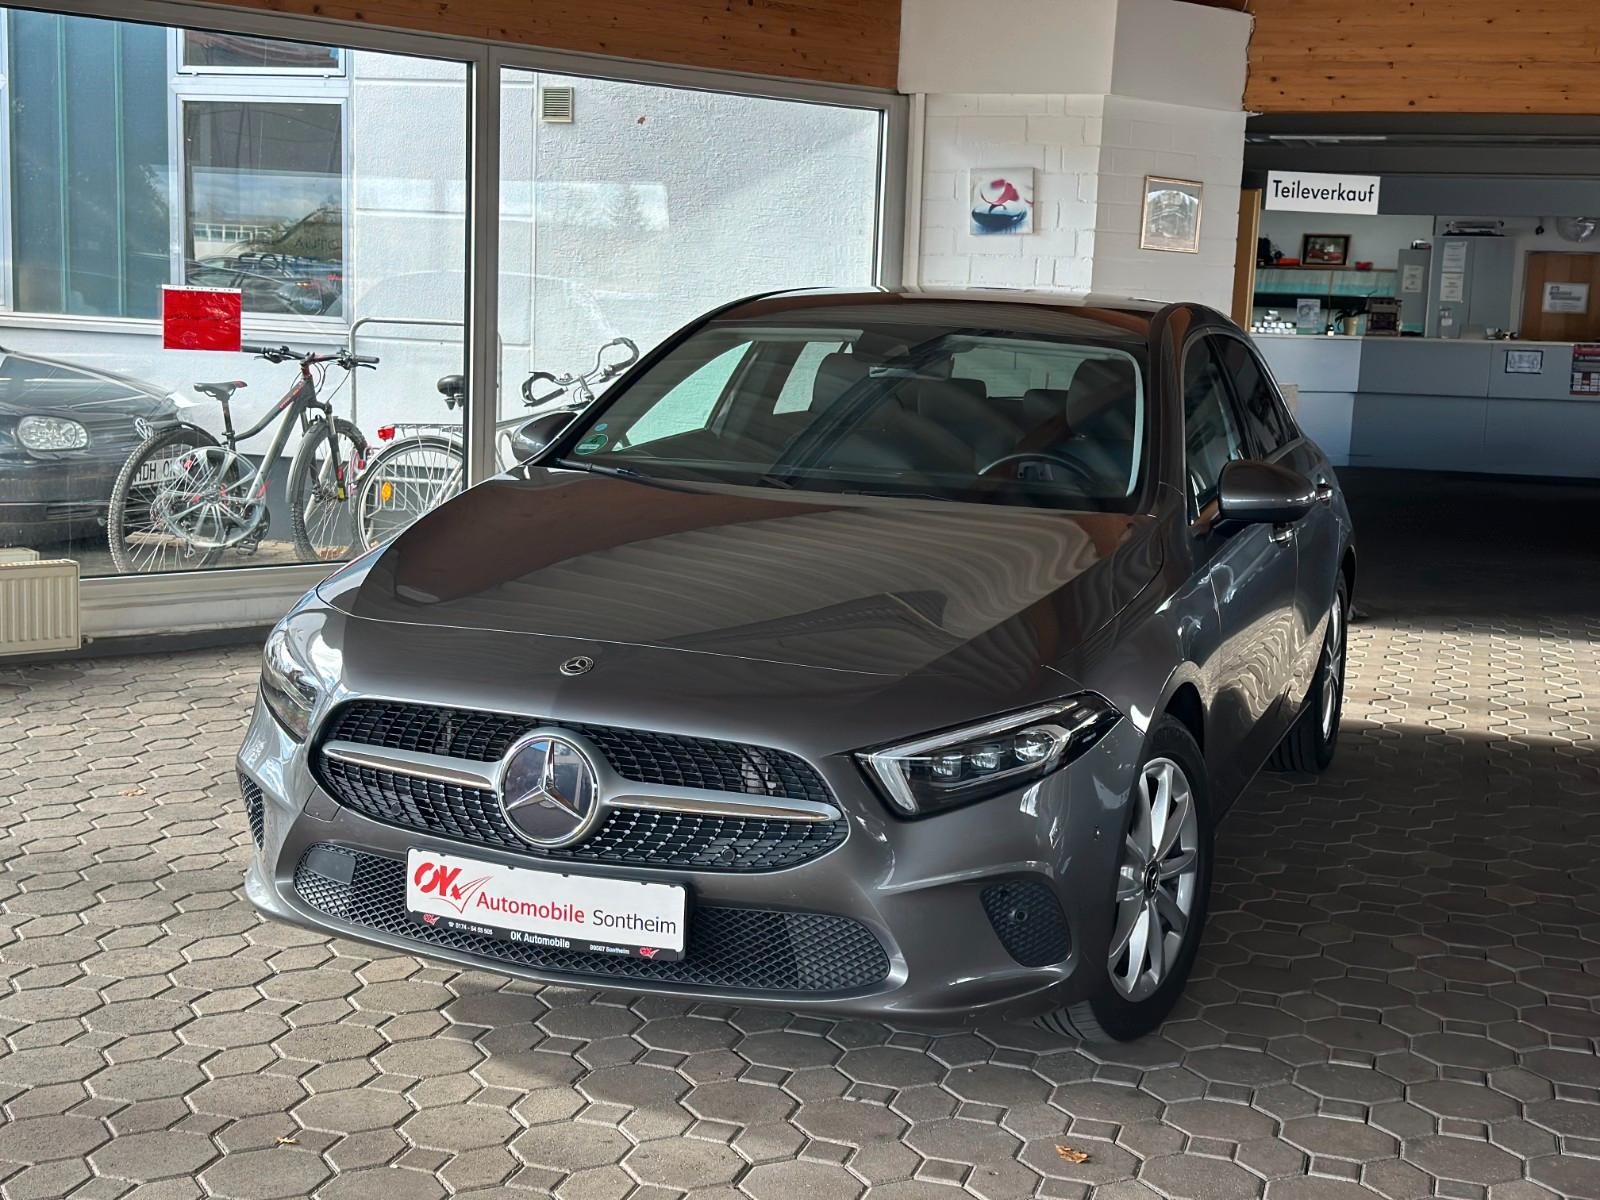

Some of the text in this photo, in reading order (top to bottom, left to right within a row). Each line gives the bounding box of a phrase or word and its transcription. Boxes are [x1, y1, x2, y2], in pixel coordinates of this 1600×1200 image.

[1272, 180, 1375, 202] Teileverkauf
[414, 862, 463, 900] OK
[476, 891, 676, 934] Automobile Sontheim
[510, 930, 571, 949] OK Automobile
